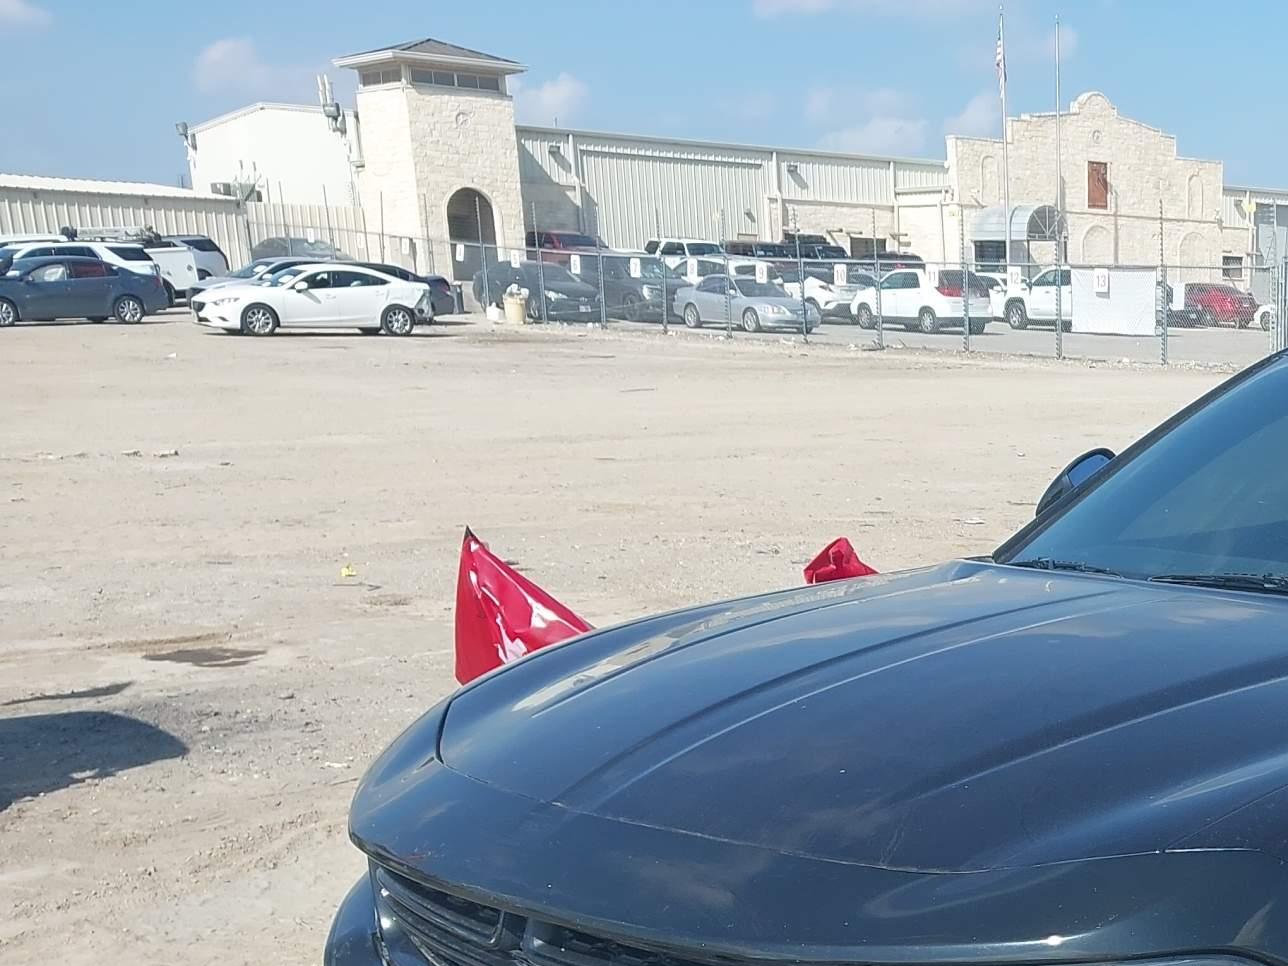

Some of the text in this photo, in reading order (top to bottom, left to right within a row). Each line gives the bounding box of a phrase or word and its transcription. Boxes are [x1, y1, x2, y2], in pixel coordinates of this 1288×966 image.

[758, 267, 765, 280] 9
[836, 269, 846, 282] 10
[928, 271, 936, 281] 11
[1010, 271, 1020, 285] 12
[1096, 274, 1106, 288] 13
